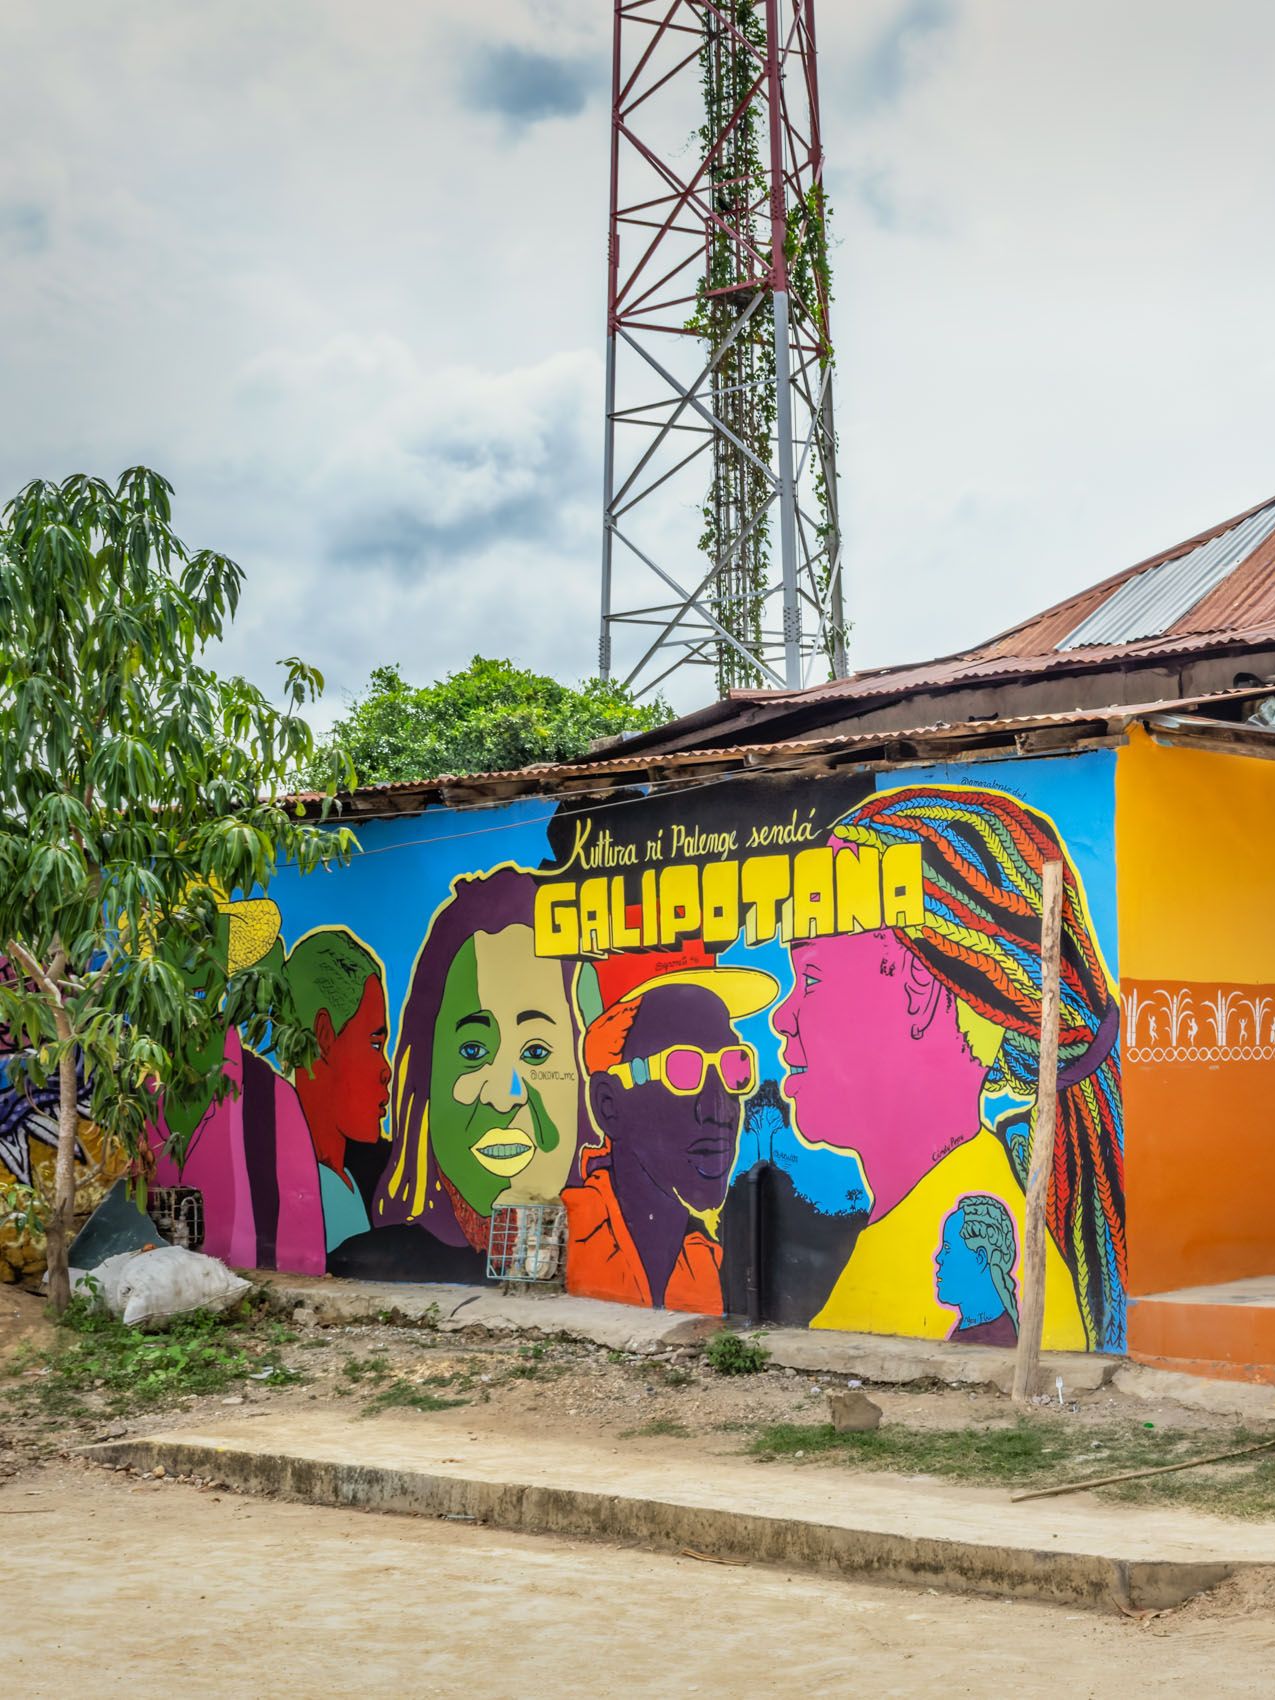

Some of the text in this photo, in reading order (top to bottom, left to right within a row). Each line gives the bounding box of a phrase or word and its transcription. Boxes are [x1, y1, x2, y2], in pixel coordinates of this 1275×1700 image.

[644, 828, 665, 862] ri
[670, 824, 739, 861] Palenge
[746, 807, 823, 849] sendá
[534, 843, 926, 958] GALIPOTANA
